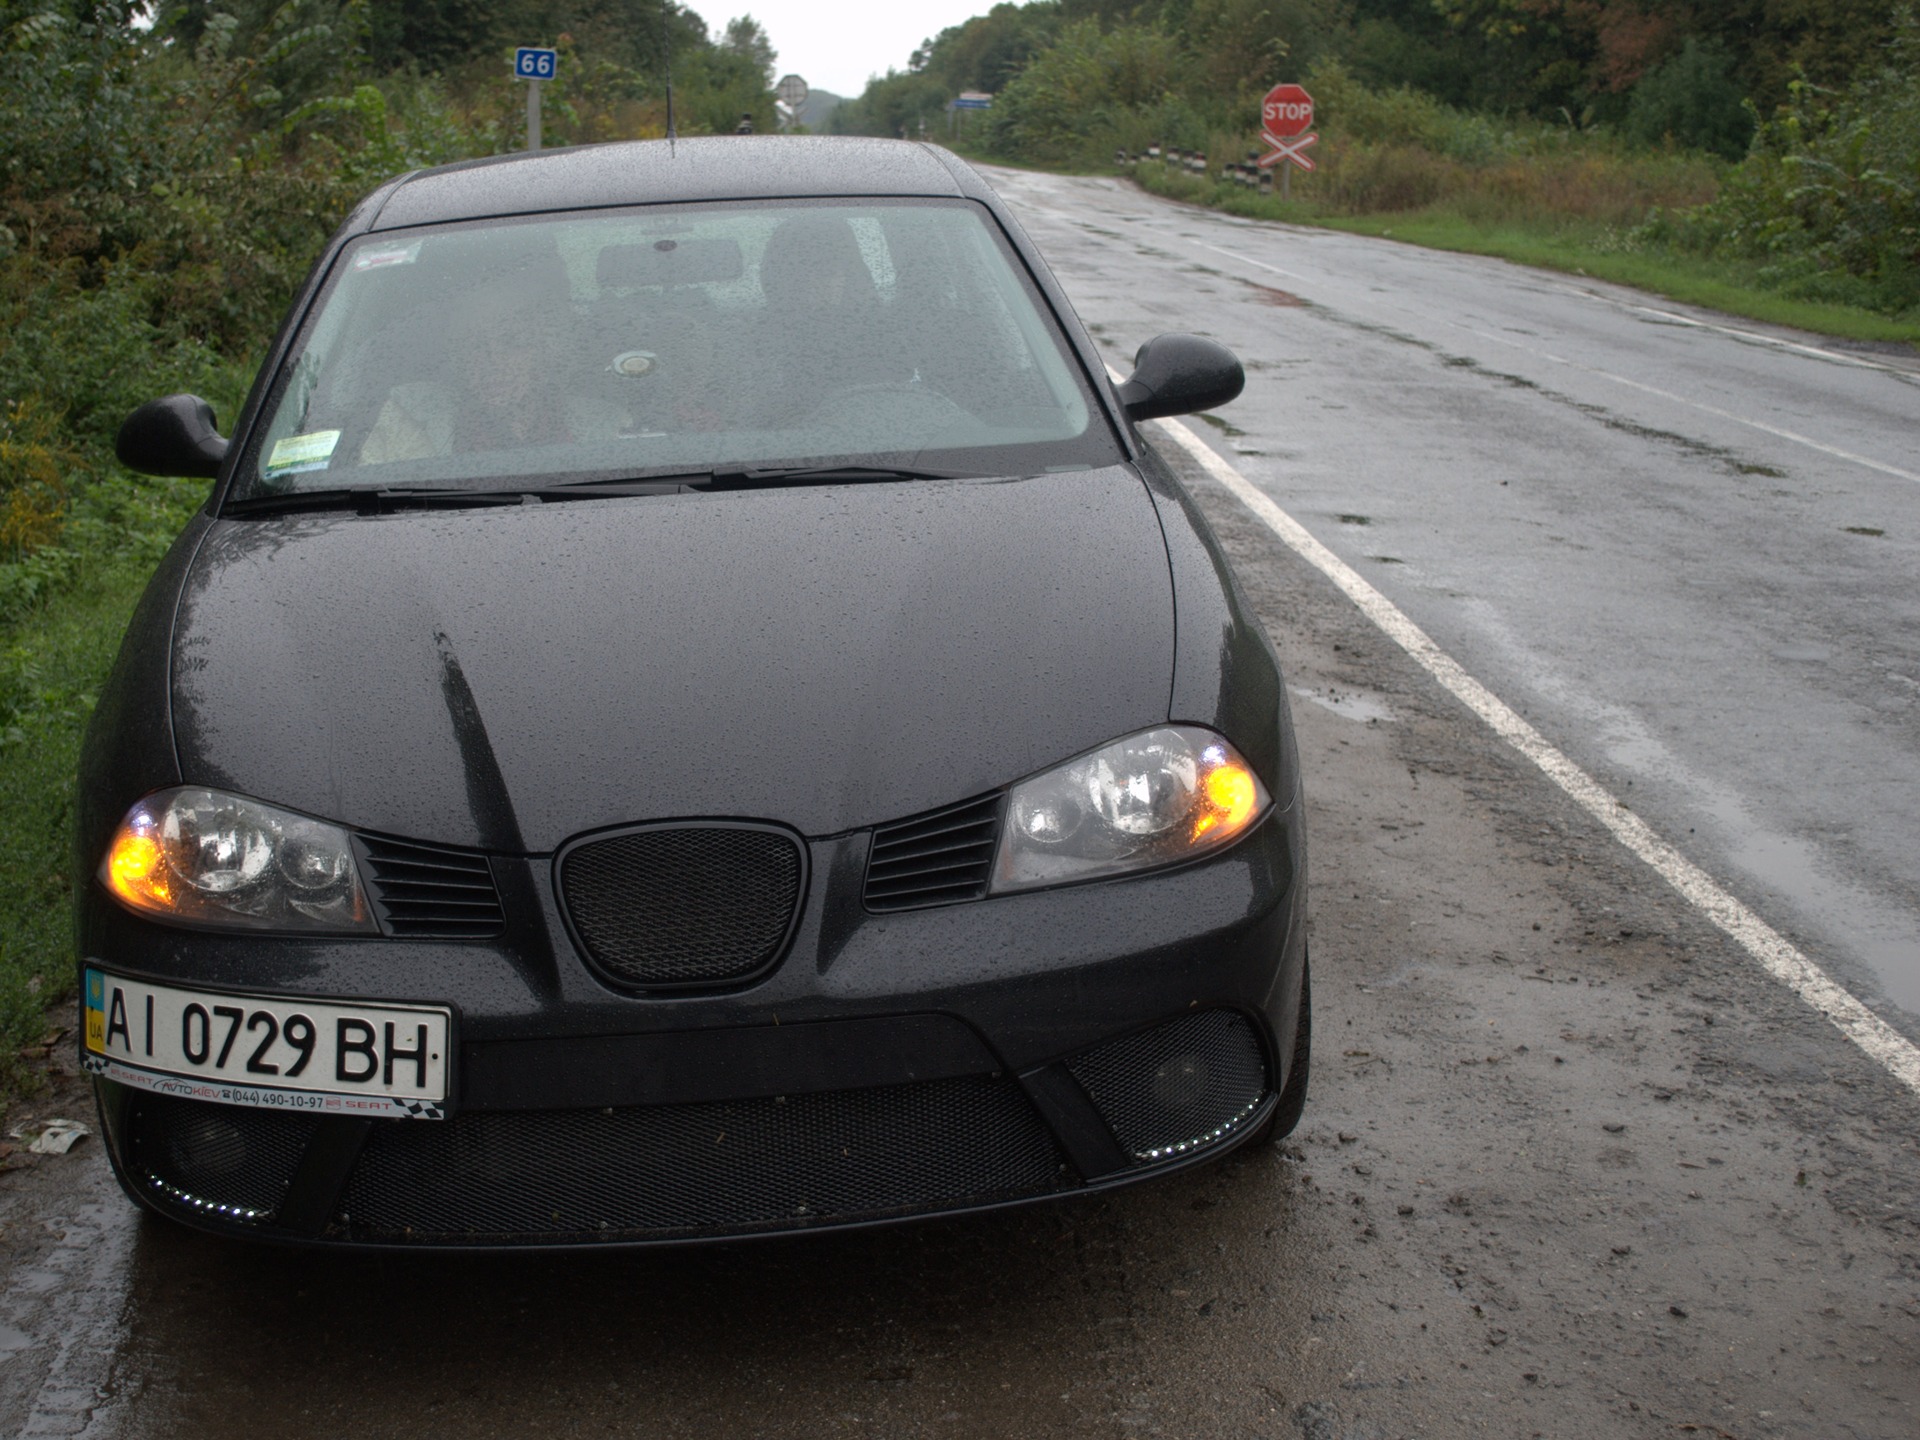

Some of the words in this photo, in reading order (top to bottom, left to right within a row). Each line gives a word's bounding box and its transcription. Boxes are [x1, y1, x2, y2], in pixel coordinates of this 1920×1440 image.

[521, 53, 551, 74] 66
[1264, 103, 1312, 121] STOP
[90, 1021, 103, 1041] UA
[107, 986, 154, 1057] AI
[182, 1002, 317, 1077] 0729
[336, 1017, 428, 1088] BH
[121, 1071, 153, 1085] SEAT
[232, 1088, 260, 1105] (044)
[262, 1094, 324, 1109] 490-10-97
[345, 1100, 392, 1110] SEAT
